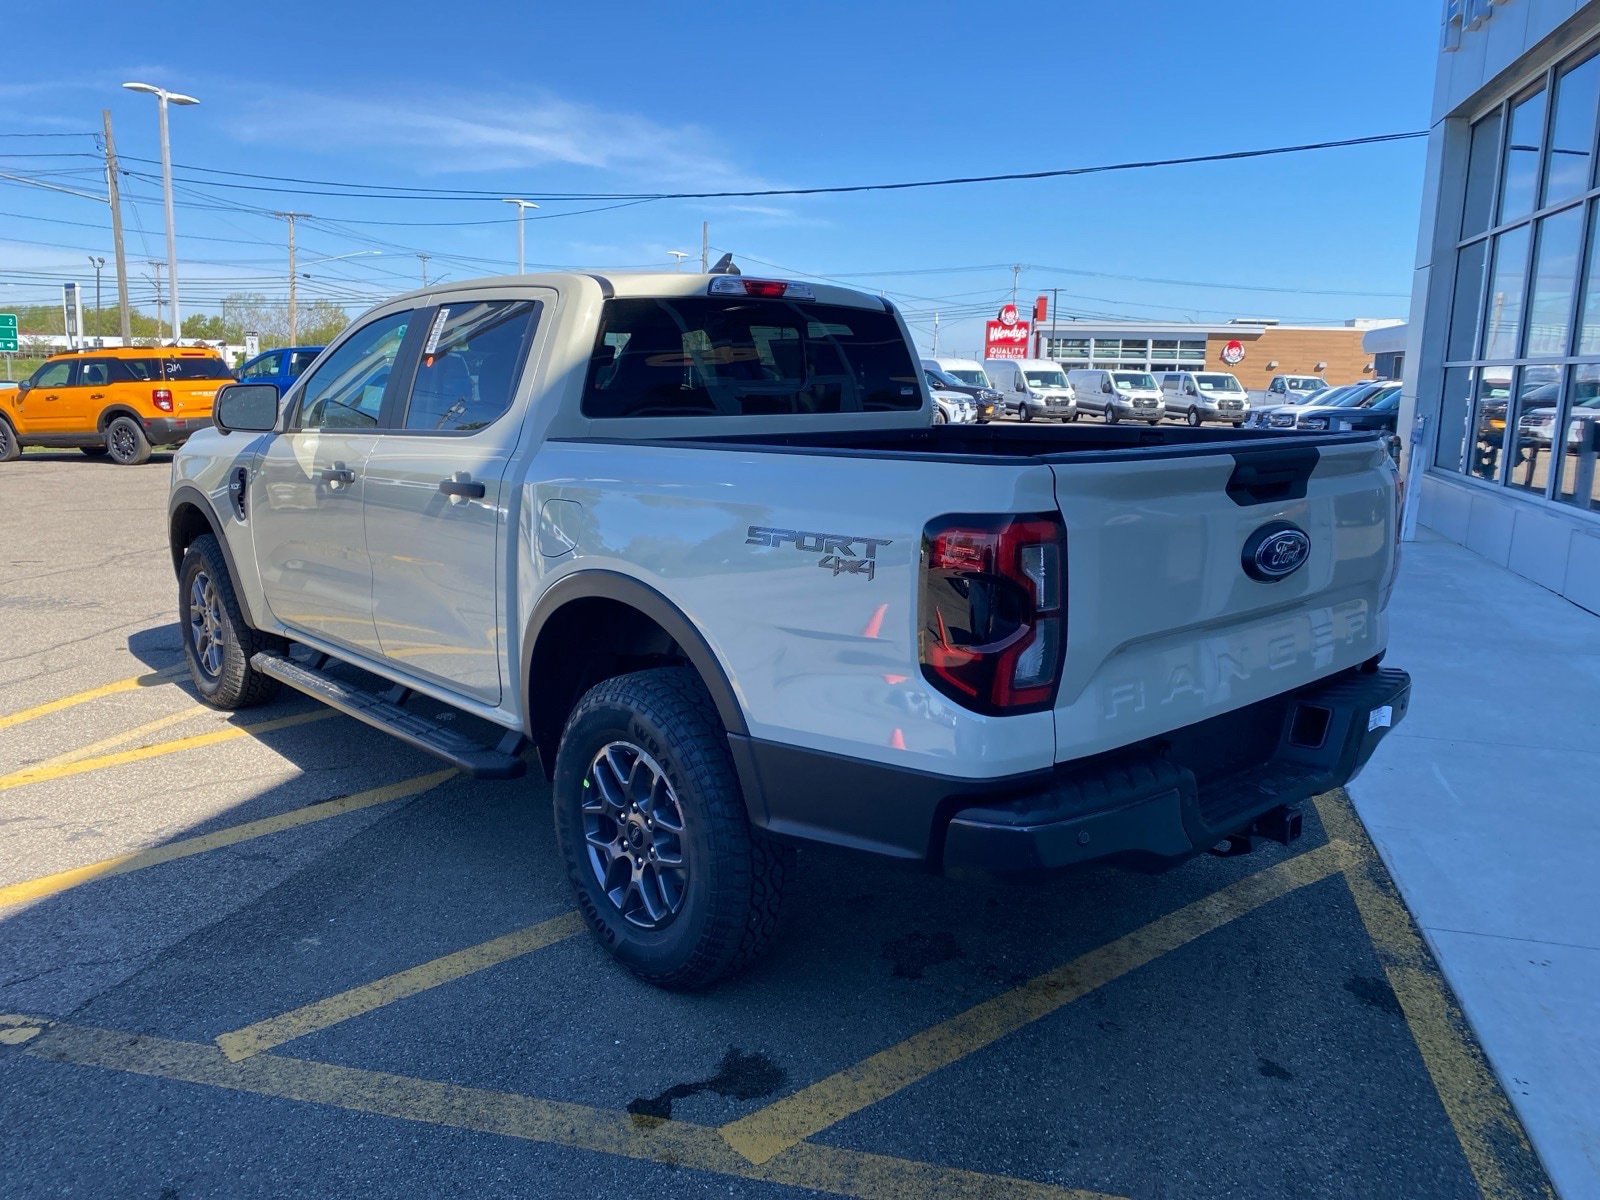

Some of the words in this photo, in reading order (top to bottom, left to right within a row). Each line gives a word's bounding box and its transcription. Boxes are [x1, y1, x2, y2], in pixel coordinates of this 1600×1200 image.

[989, 325, 1027, 342] Wendy's
[745, 526, 893, 559] SPORT
[1105, 598, 1369, 720] RANGER
